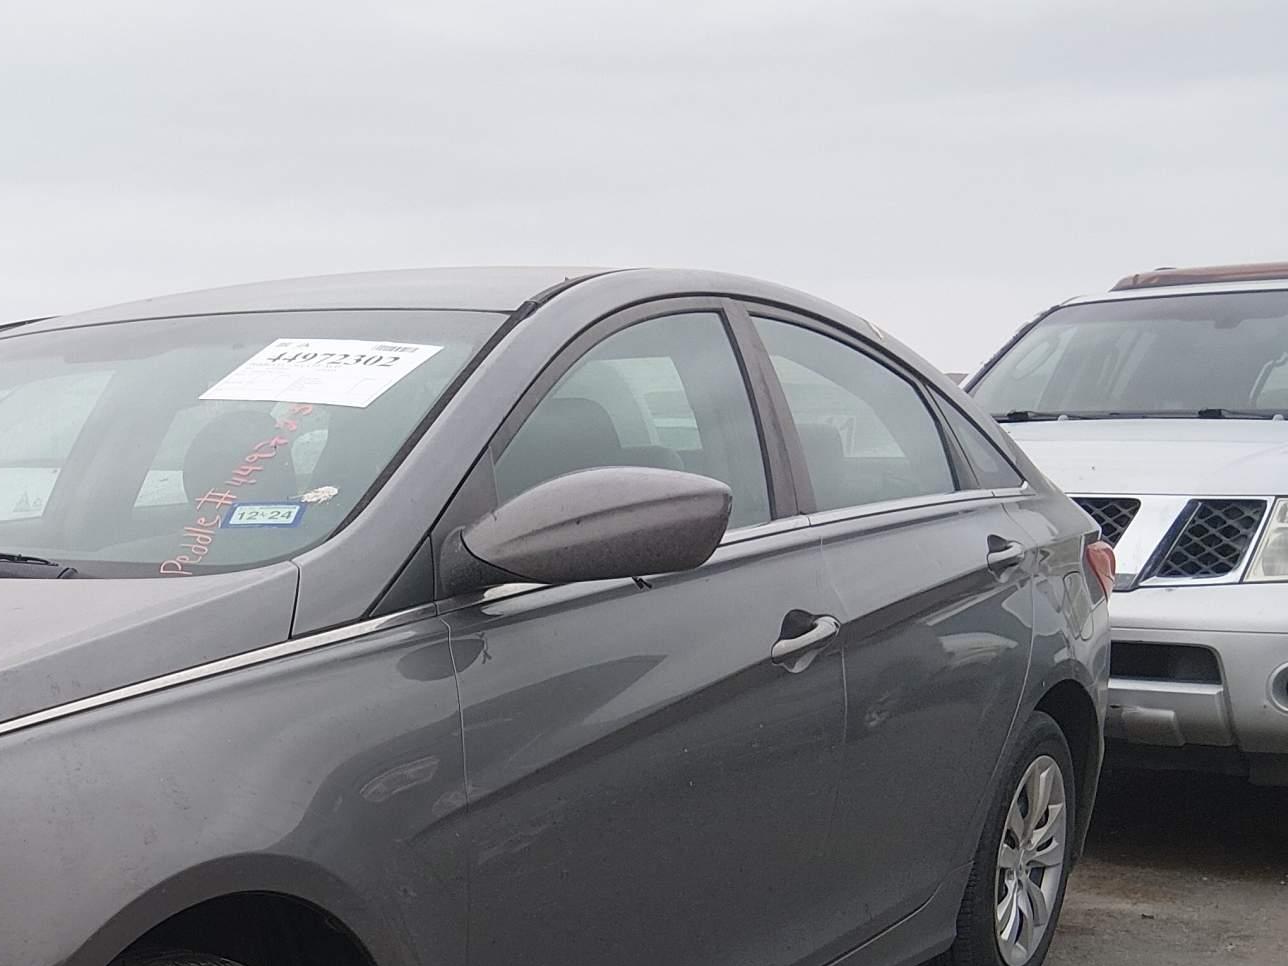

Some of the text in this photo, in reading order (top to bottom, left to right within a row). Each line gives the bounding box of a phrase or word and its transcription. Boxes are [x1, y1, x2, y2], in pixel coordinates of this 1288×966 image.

[267, 351, 401, 368] 44972302
[237, 510, 293, 521] 12 24
